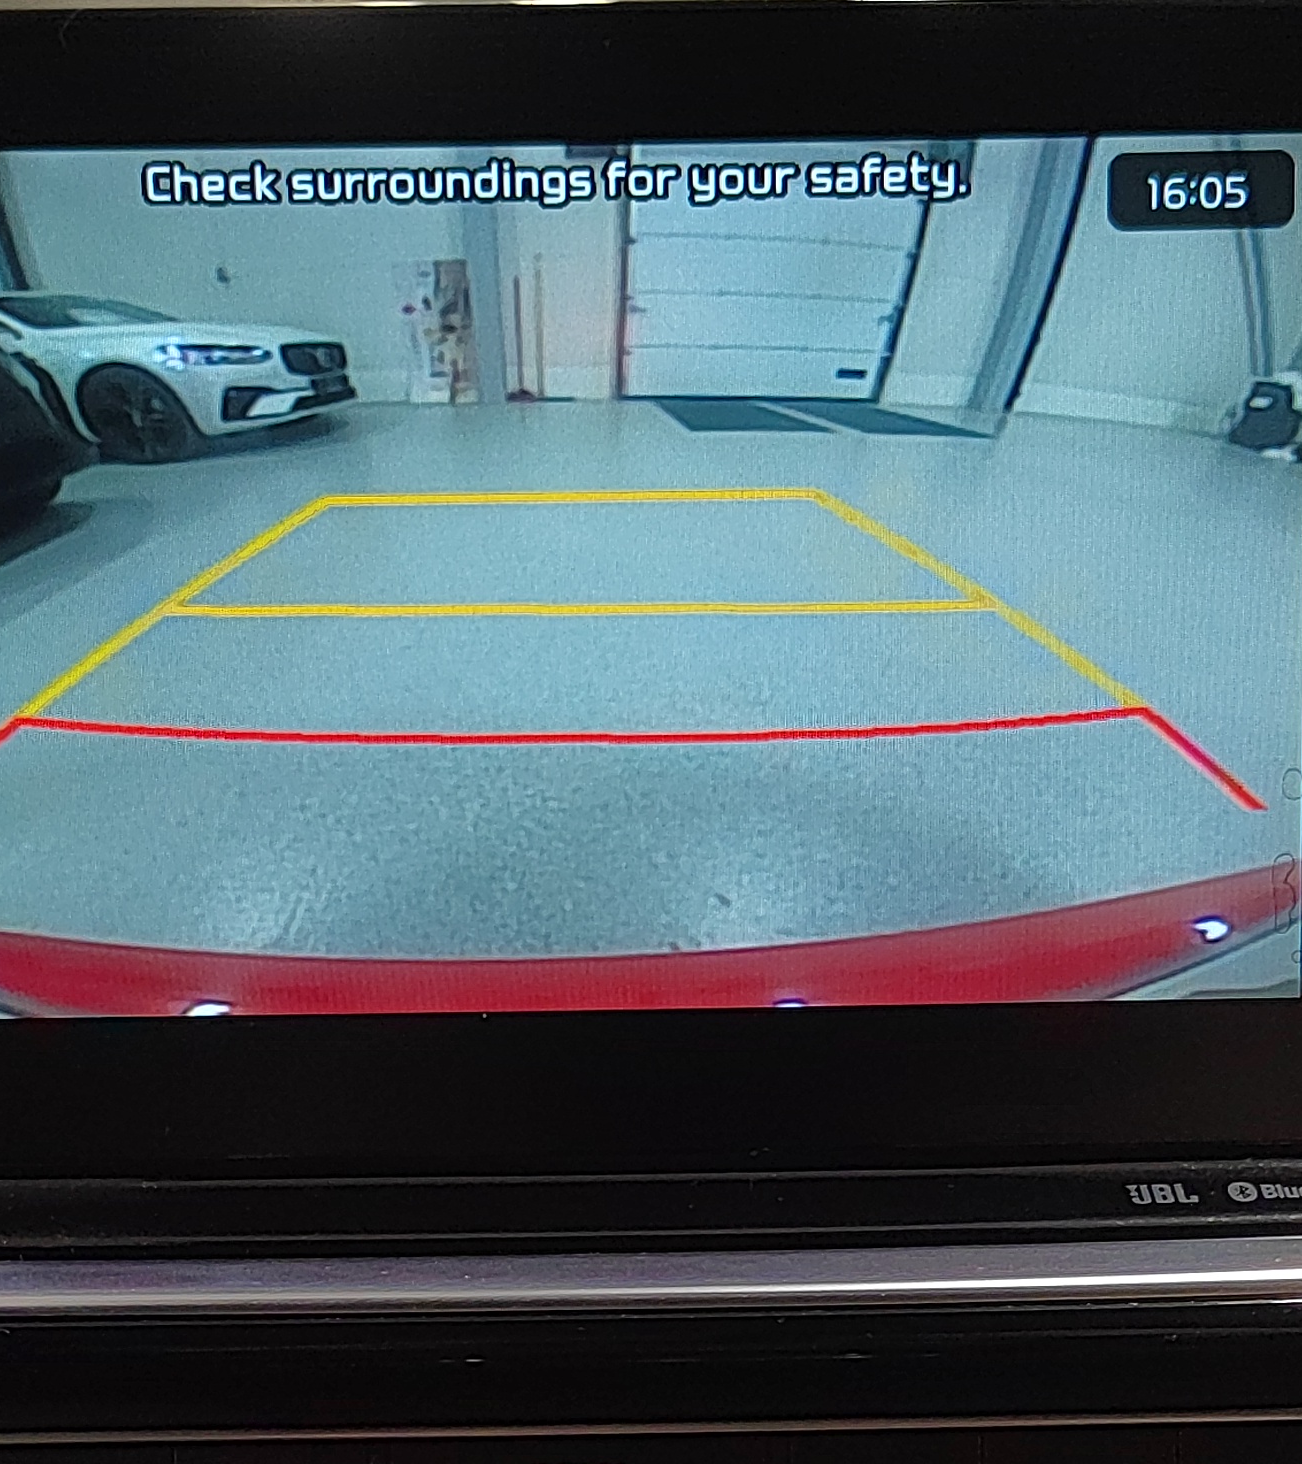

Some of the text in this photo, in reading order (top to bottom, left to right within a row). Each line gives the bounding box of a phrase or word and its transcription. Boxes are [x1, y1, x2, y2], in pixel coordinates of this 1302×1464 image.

[145, 153, 970, 206] Check surroundings for your safety.
[1147, 171, 1249, 211] 16:05
[1125, 1183, 1199, 1205] JBL
